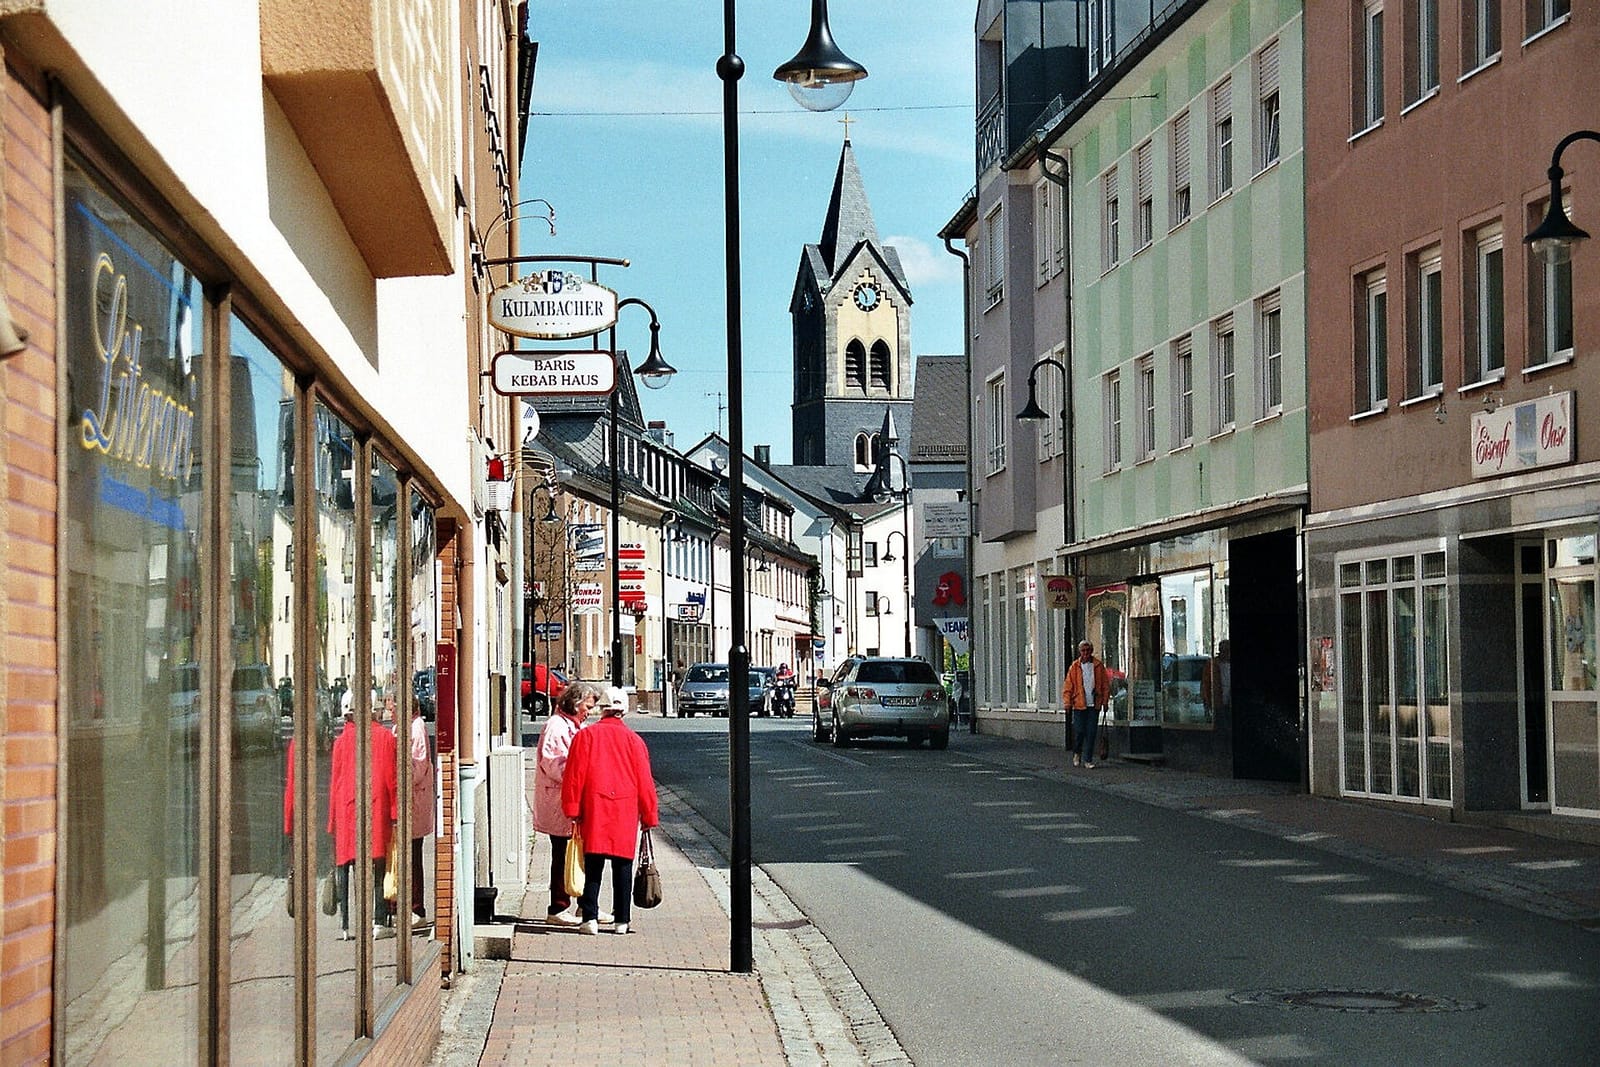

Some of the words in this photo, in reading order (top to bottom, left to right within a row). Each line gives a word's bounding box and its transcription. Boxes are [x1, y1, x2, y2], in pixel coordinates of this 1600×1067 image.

[502, 298, 603, 318] KULMBACHER
[534, 360, 575, 371] BARIS
[511, 375, 557, 387] KEBAB
[561, 374, 599, 386] HAUS
[574, 588, 602, 596] KONRAD
[575, 597, 600, 606] REISEN
